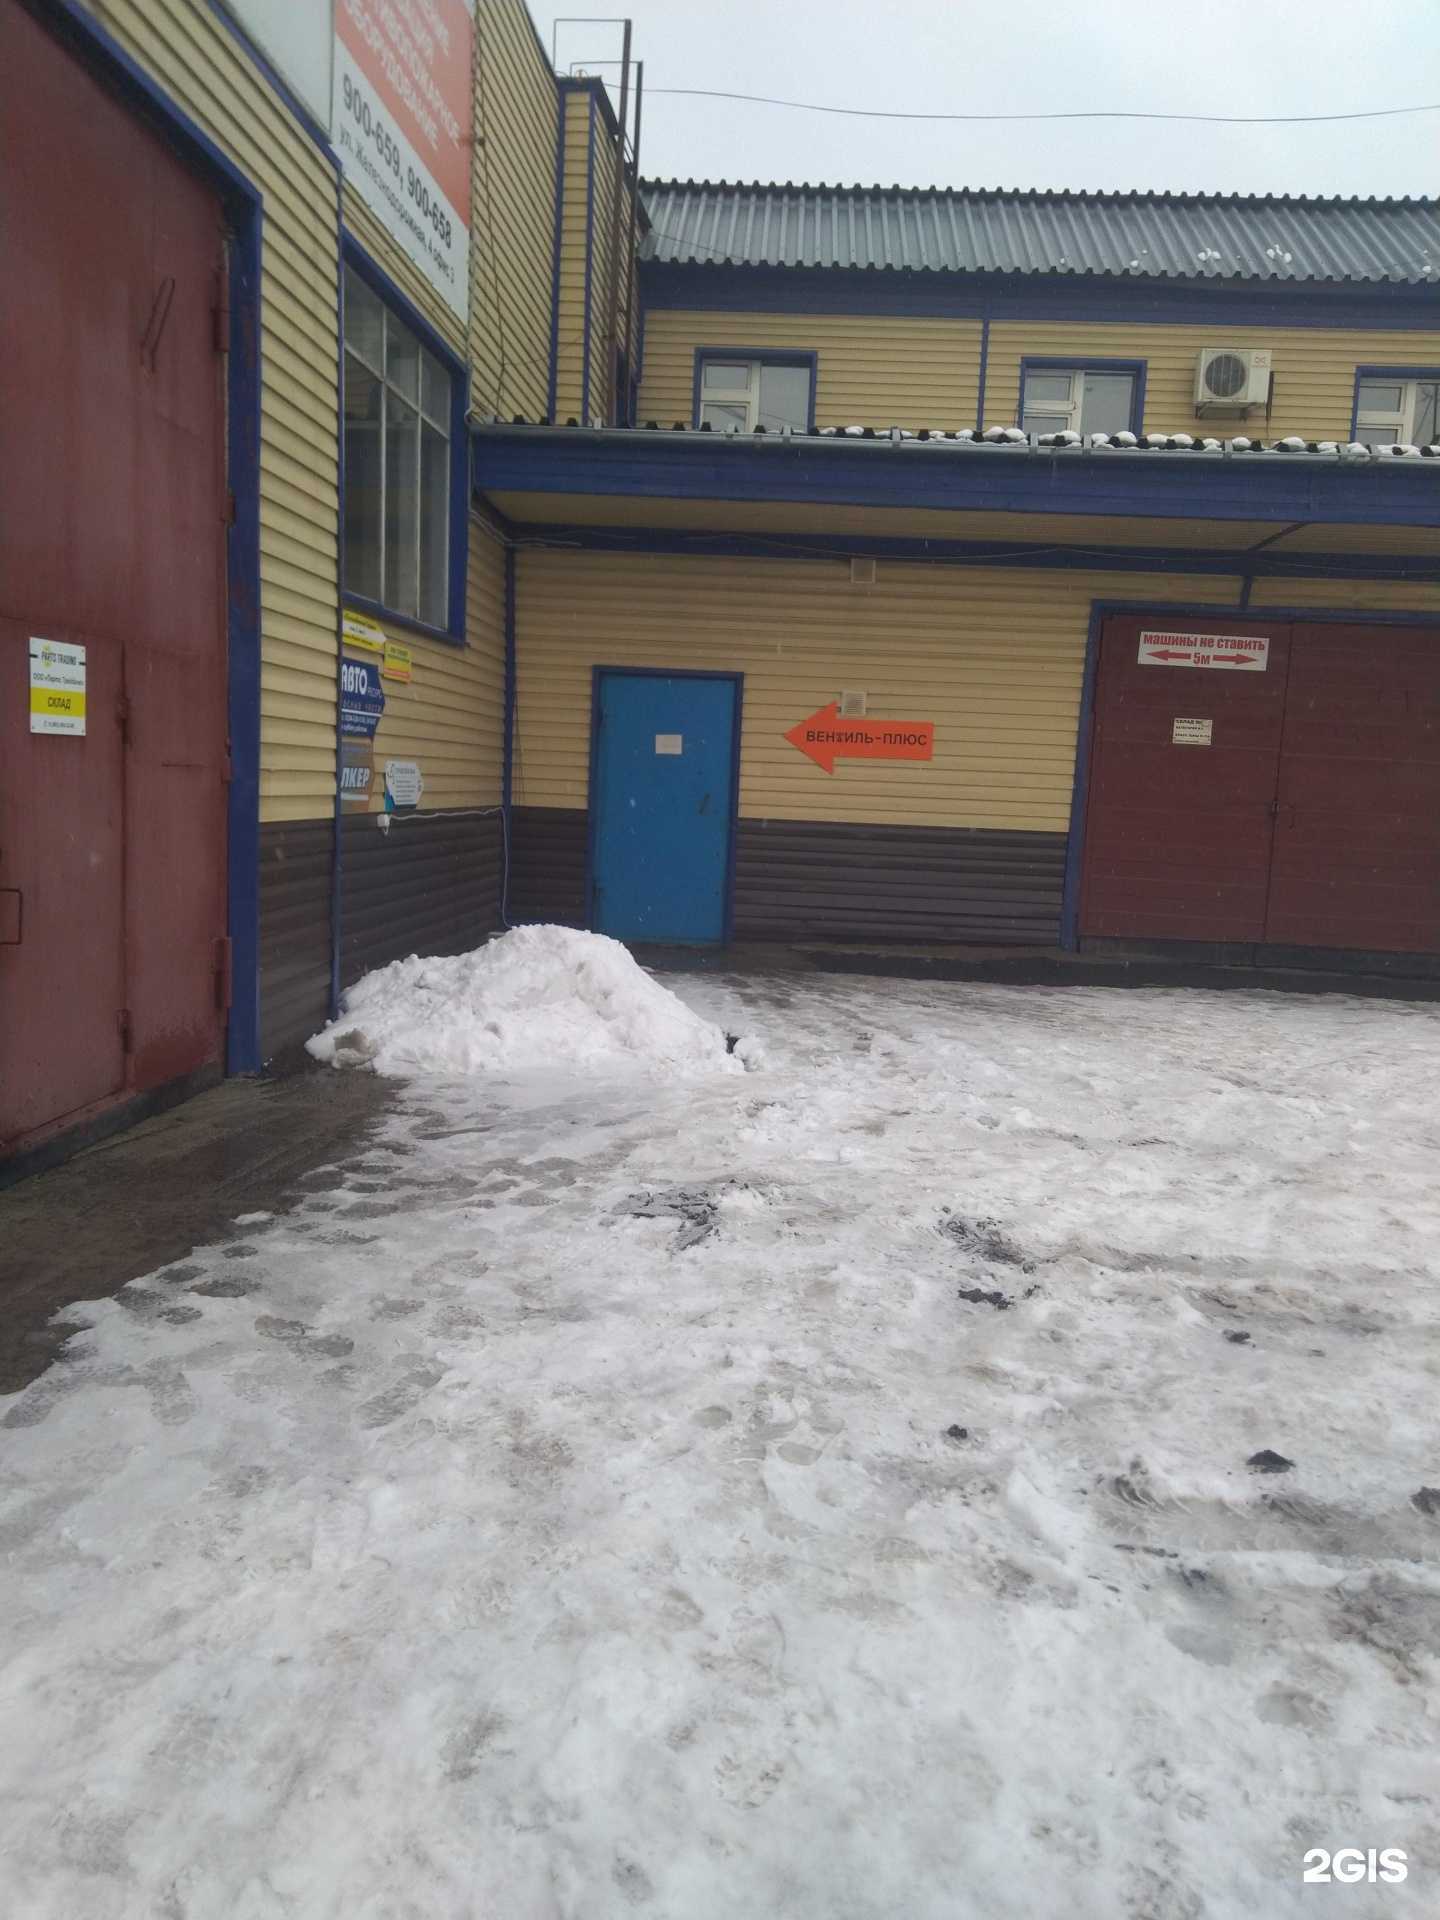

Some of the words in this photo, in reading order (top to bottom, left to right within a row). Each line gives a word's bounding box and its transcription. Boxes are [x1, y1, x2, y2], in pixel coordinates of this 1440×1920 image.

[343, 73, 403, 190] 900-659,
[407, 166, 452, 249] 900-658
[1143, 634, 1198, 649] машины
[1199, 637, 1214, 649] не
[1216, 639, 1265, 651] ставить
[1193, 652, 1210, 666] 5м
[47, 697, 71, 711] СКЛАД
